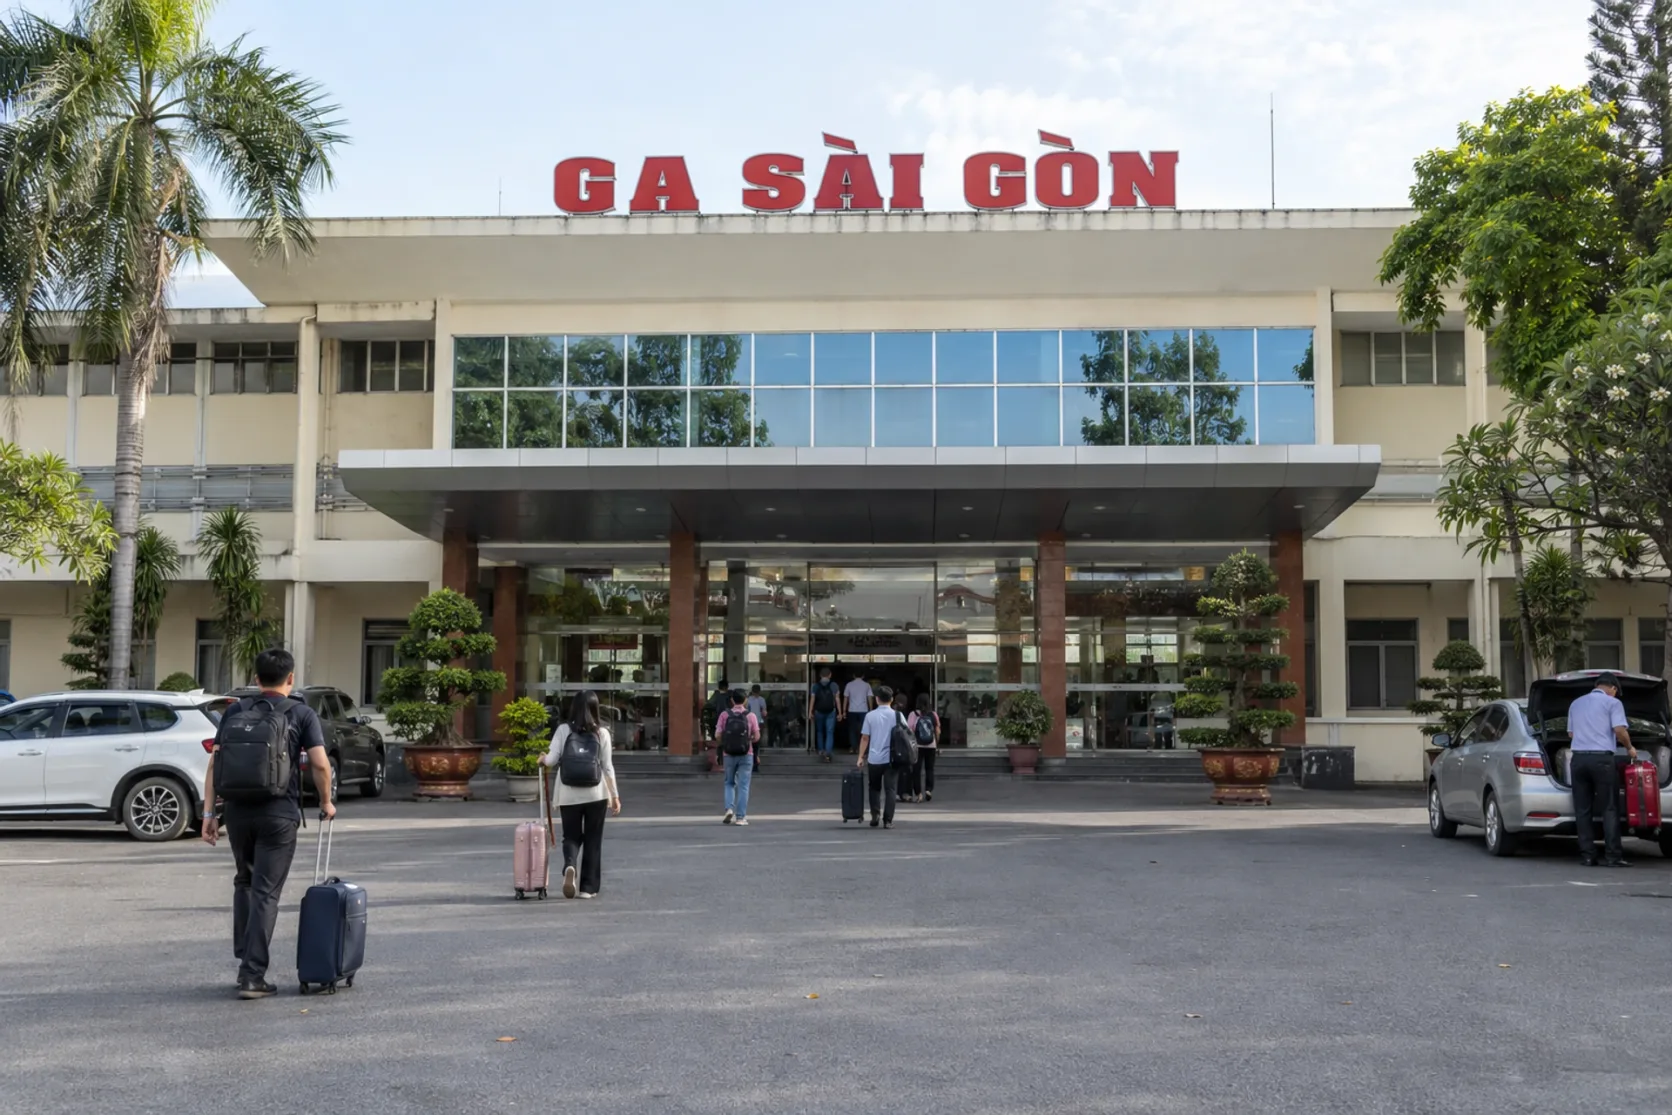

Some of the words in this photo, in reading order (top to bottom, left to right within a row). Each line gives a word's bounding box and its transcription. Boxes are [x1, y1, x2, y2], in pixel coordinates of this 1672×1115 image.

[553, 156, 700, 213] GA
[742, 131, 924, 211] SÀI
[963, 129, 1179, 209] GÒN
